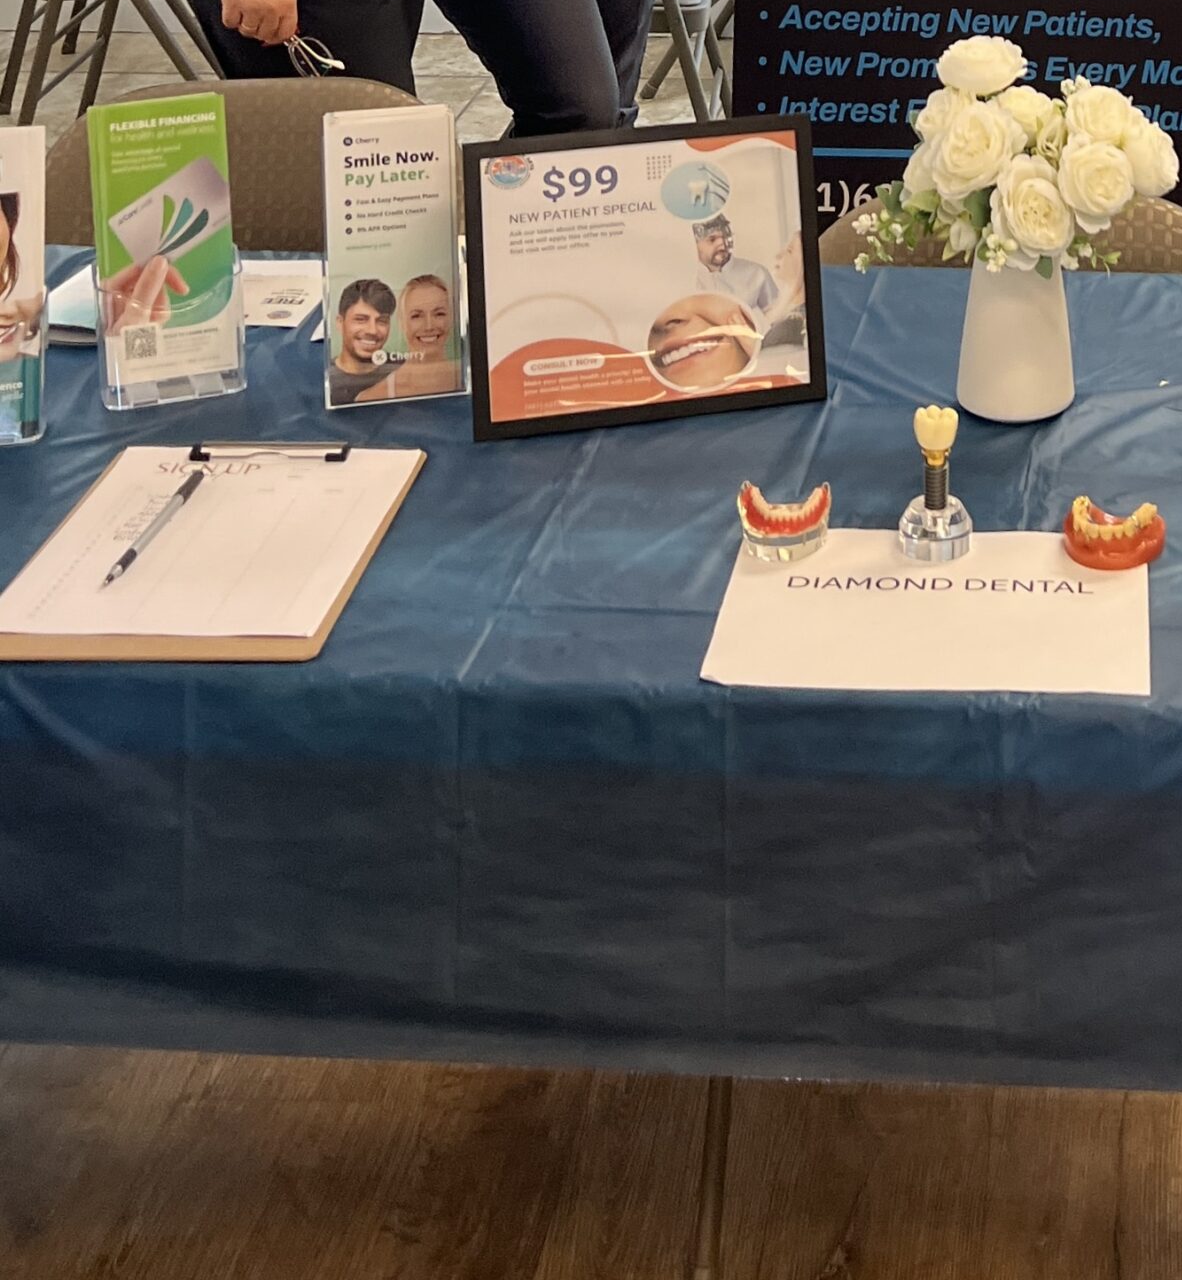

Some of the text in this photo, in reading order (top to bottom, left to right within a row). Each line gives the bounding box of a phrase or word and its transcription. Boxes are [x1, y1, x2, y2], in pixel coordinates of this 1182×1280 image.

[779, 4, 1162, 44] Accepting New Patients,
[779, 50, 853, 76] New
[1044, 55, 1137, 88] Every
[779, 96, 901, 124] Interest
[110, 112, 216, 132] FLEXIBLE FINANCING
[344, 151, 439, 169] Smile Now.
[345, 169, 430, 188] Pay Later.
[542, 165, 619, 203] $99
[509, 201, 656, 225] NEW PATIENT SPECIAL
[389, 348, 425, 362] Cherry
[530, 358, 598, 372] CONSULT NOW
[225, 463, 261, 476] UP
[787, 575, 1094, 595] DIAMOND DENTAL
